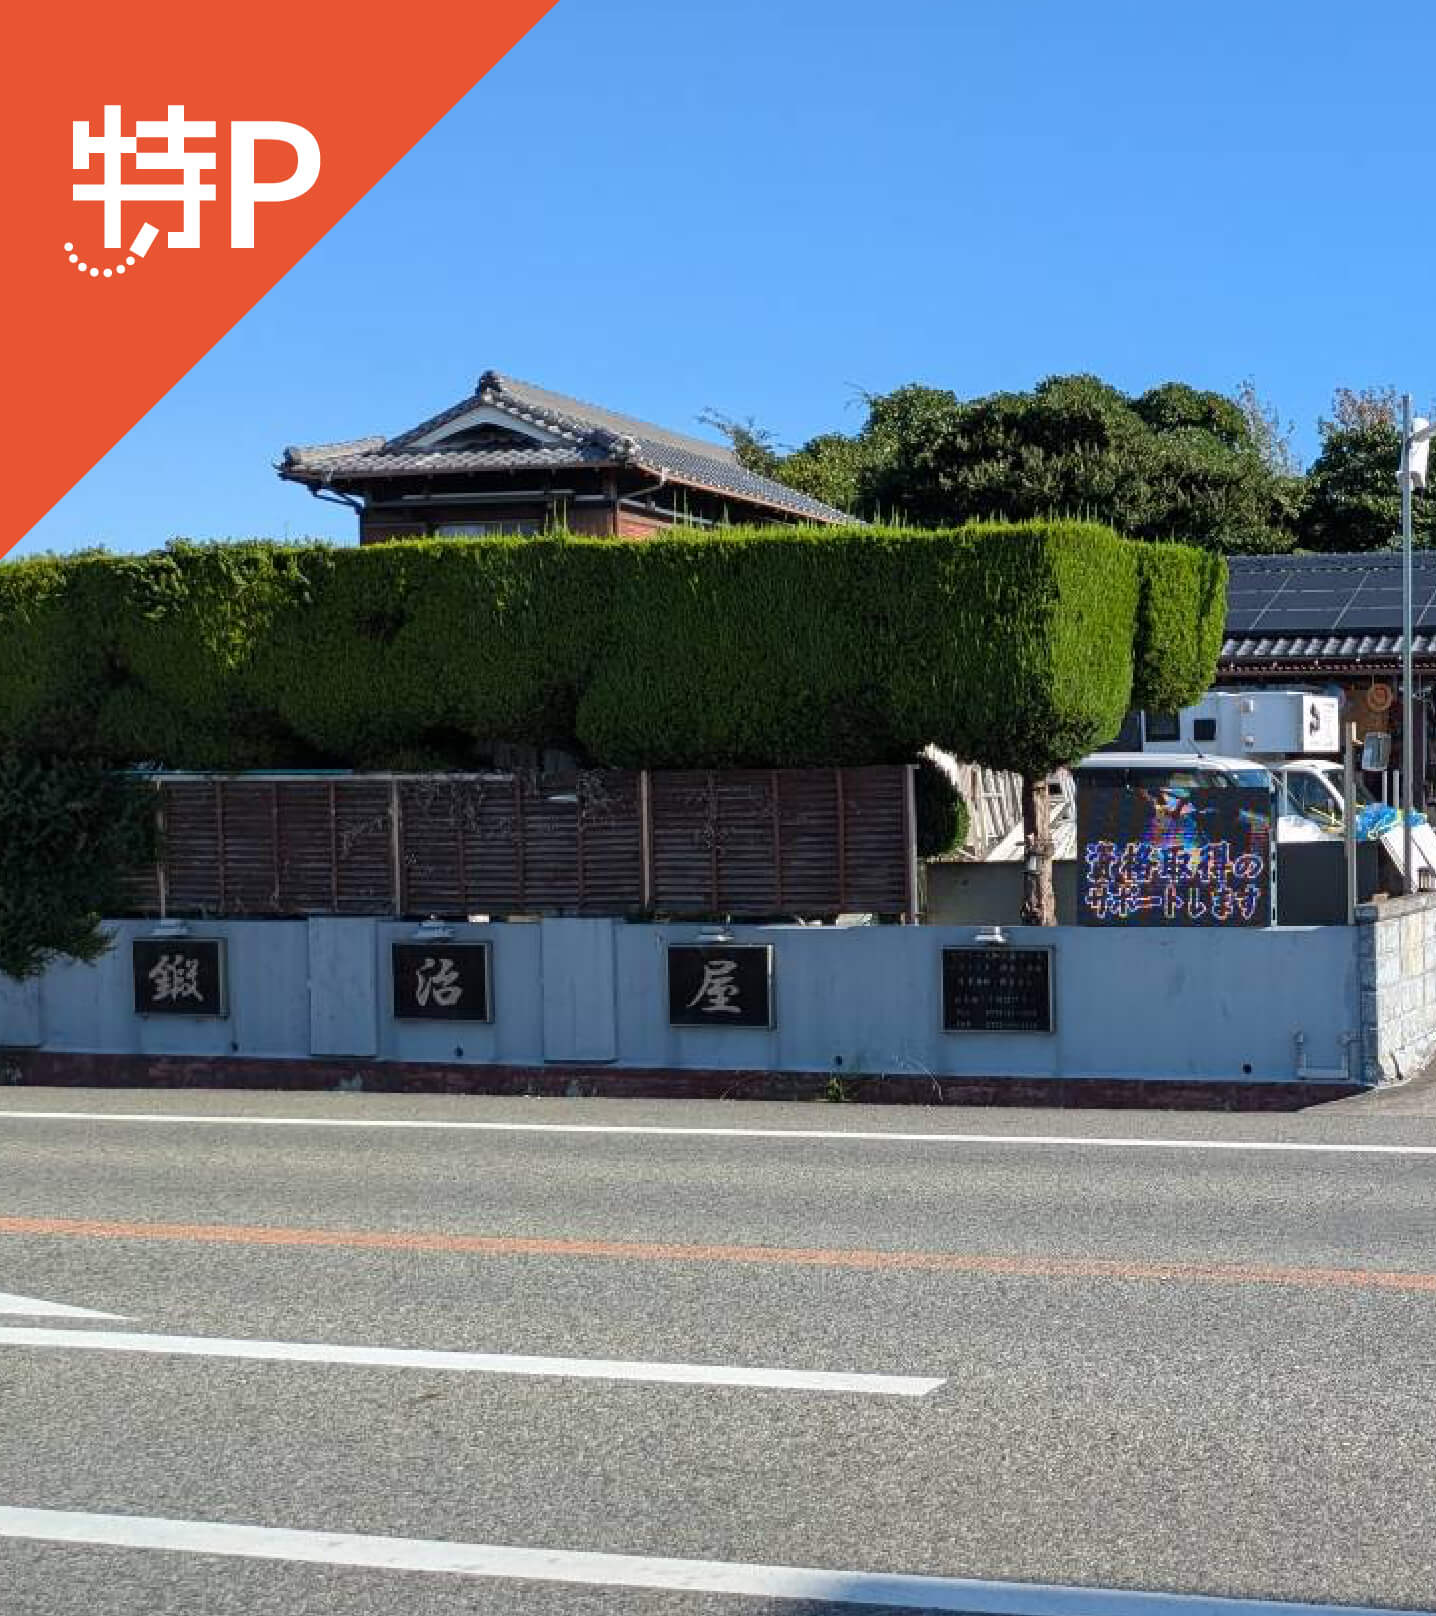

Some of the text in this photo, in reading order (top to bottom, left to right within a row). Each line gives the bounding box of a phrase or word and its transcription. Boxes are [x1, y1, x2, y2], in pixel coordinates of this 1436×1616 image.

[1086, 841, 1264, 886] 資格取得の
[1086, 884, 1262, 920] サポートします
[686, 960, 742, 1013] 屋
